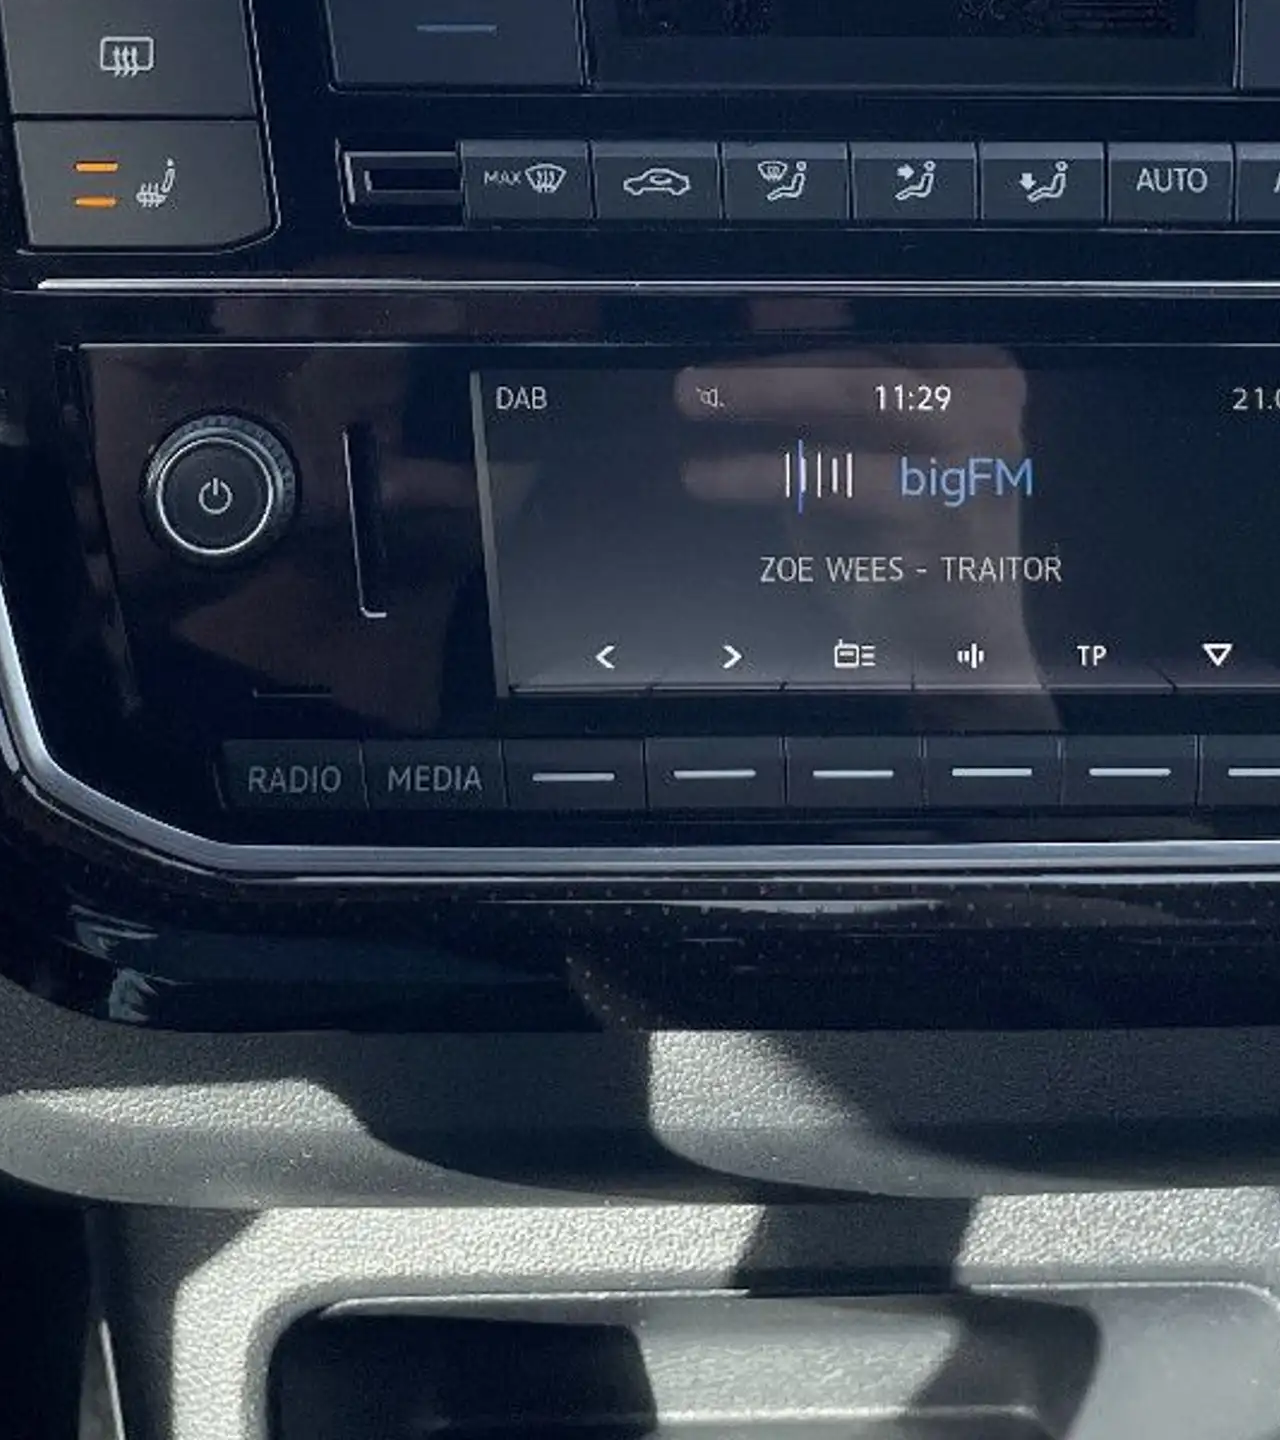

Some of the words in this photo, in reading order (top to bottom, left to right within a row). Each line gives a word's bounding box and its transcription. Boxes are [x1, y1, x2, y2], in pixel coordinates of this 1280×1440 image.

[483, 169, 522, 187] MAX
[1135, 166, 1209, 194] AUTO
[496, 386, 548, 411] DAB
[874, 385, 953, 412] 11:29
[898, 455, 1034, 508] bigFM
[758, 556, 815, 583] ZOE
[825, 556, 904, 583] WEES
[941, 556, 1063, 583] TRAITOR
[1076, 645, 1108, 667] TP
[247, 765, 343, 794] RADIO
[387, 765, 483, 792] MEDIA
